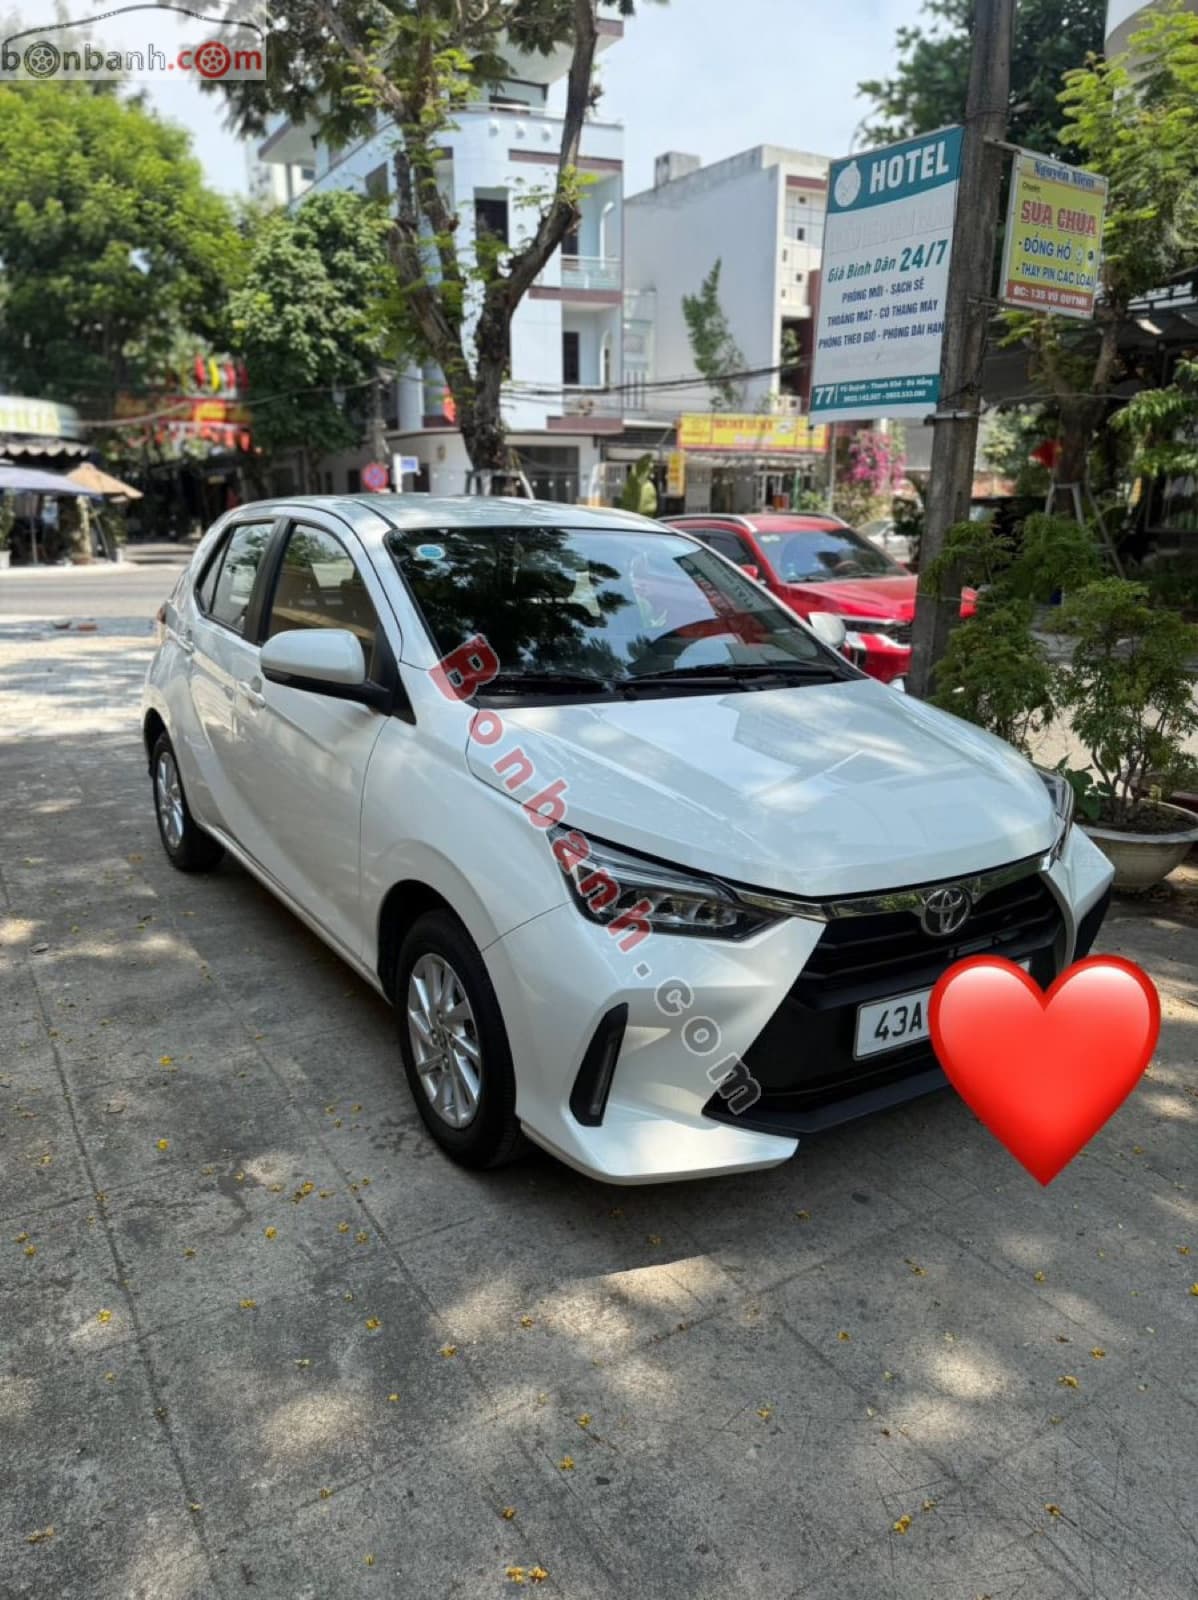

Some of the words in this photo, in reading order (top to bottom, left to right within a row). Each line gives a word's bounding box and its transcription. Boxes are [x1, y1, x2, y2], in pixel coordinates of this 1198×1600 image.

[870, 141, 949, 194] HOTEL
[899, 239, 949, 272] 24/7
[815, 386, 835, 405] 77
[874, 1002, 923, 1040] 43A
